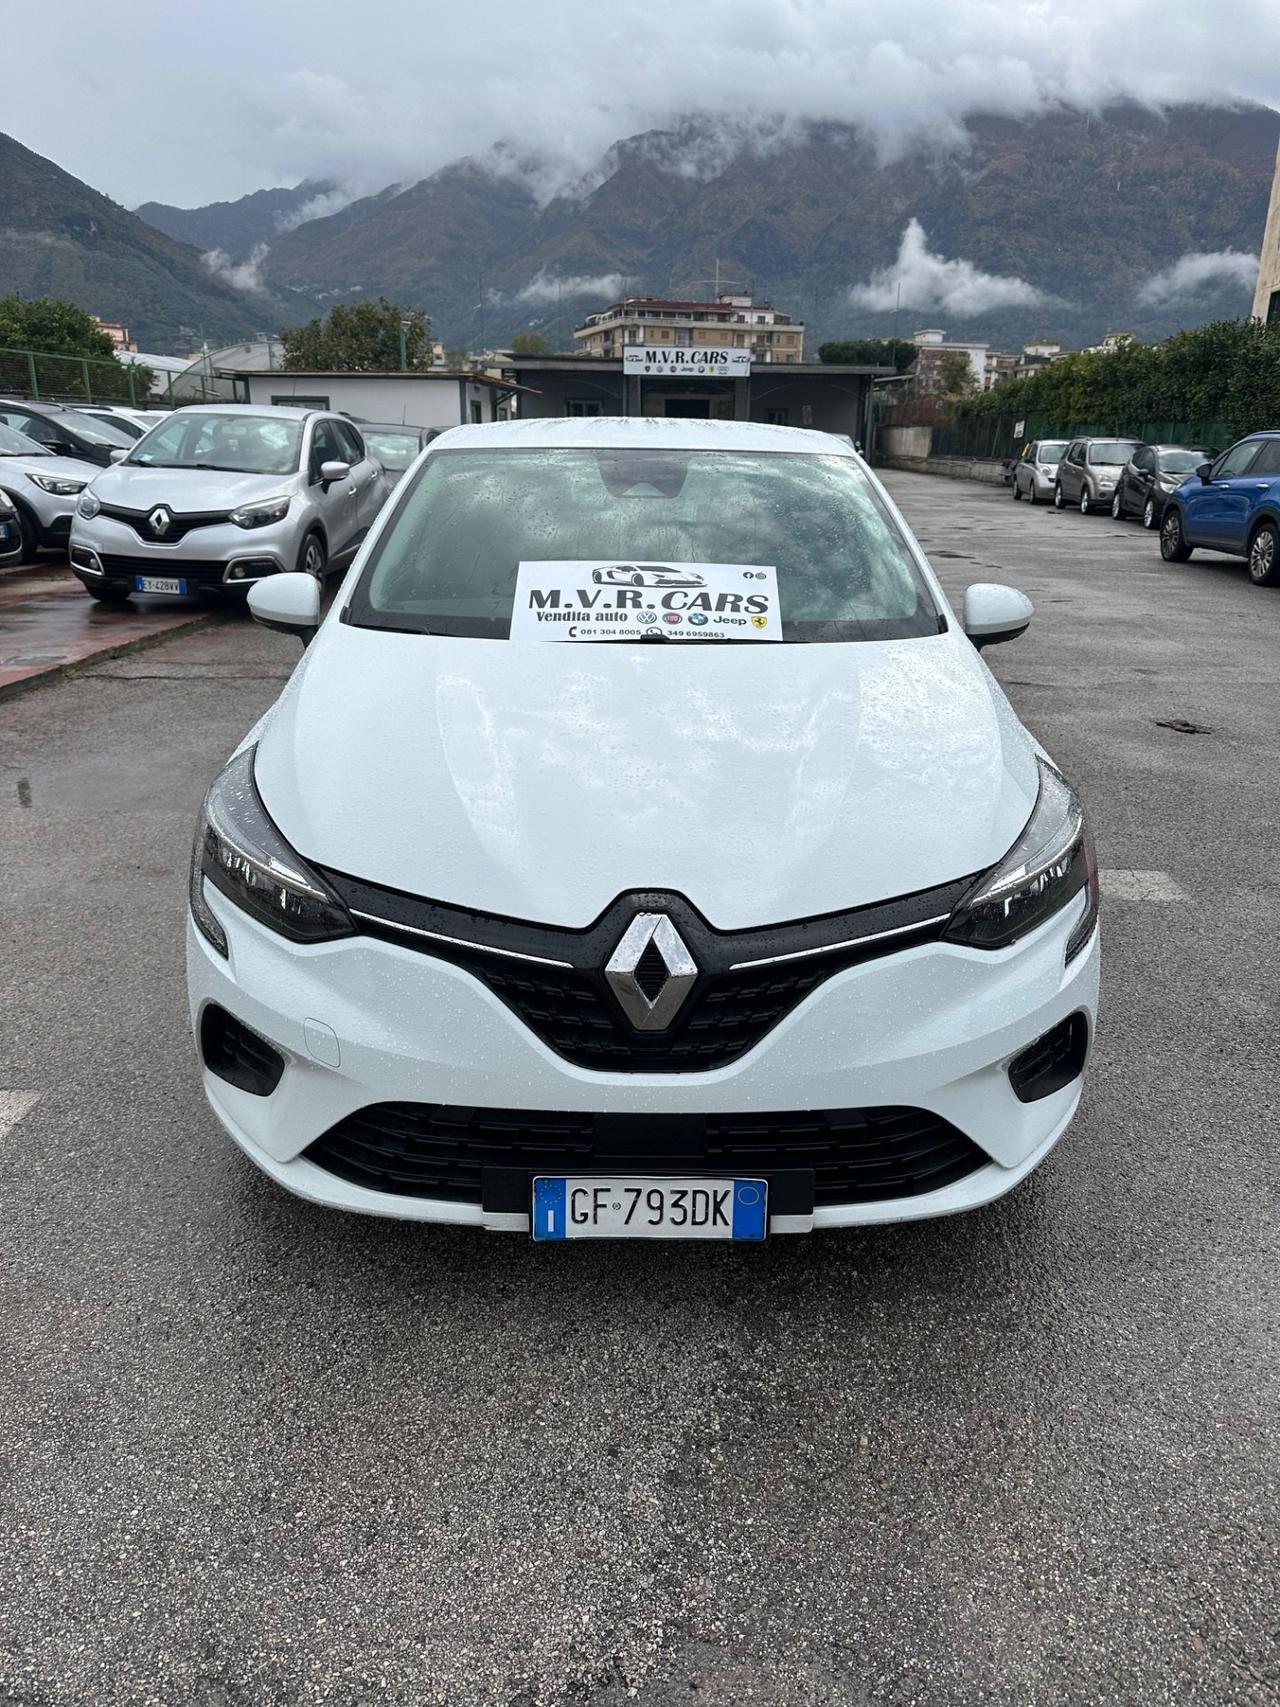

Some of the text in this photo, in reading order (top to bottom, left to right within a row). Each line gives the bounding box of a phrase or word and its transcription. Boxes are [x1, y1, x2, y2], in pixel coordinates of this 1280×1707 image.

[536, 611, 747, 626] Vendita auto Jeep
[685, 630, 725, 638] 6959863
